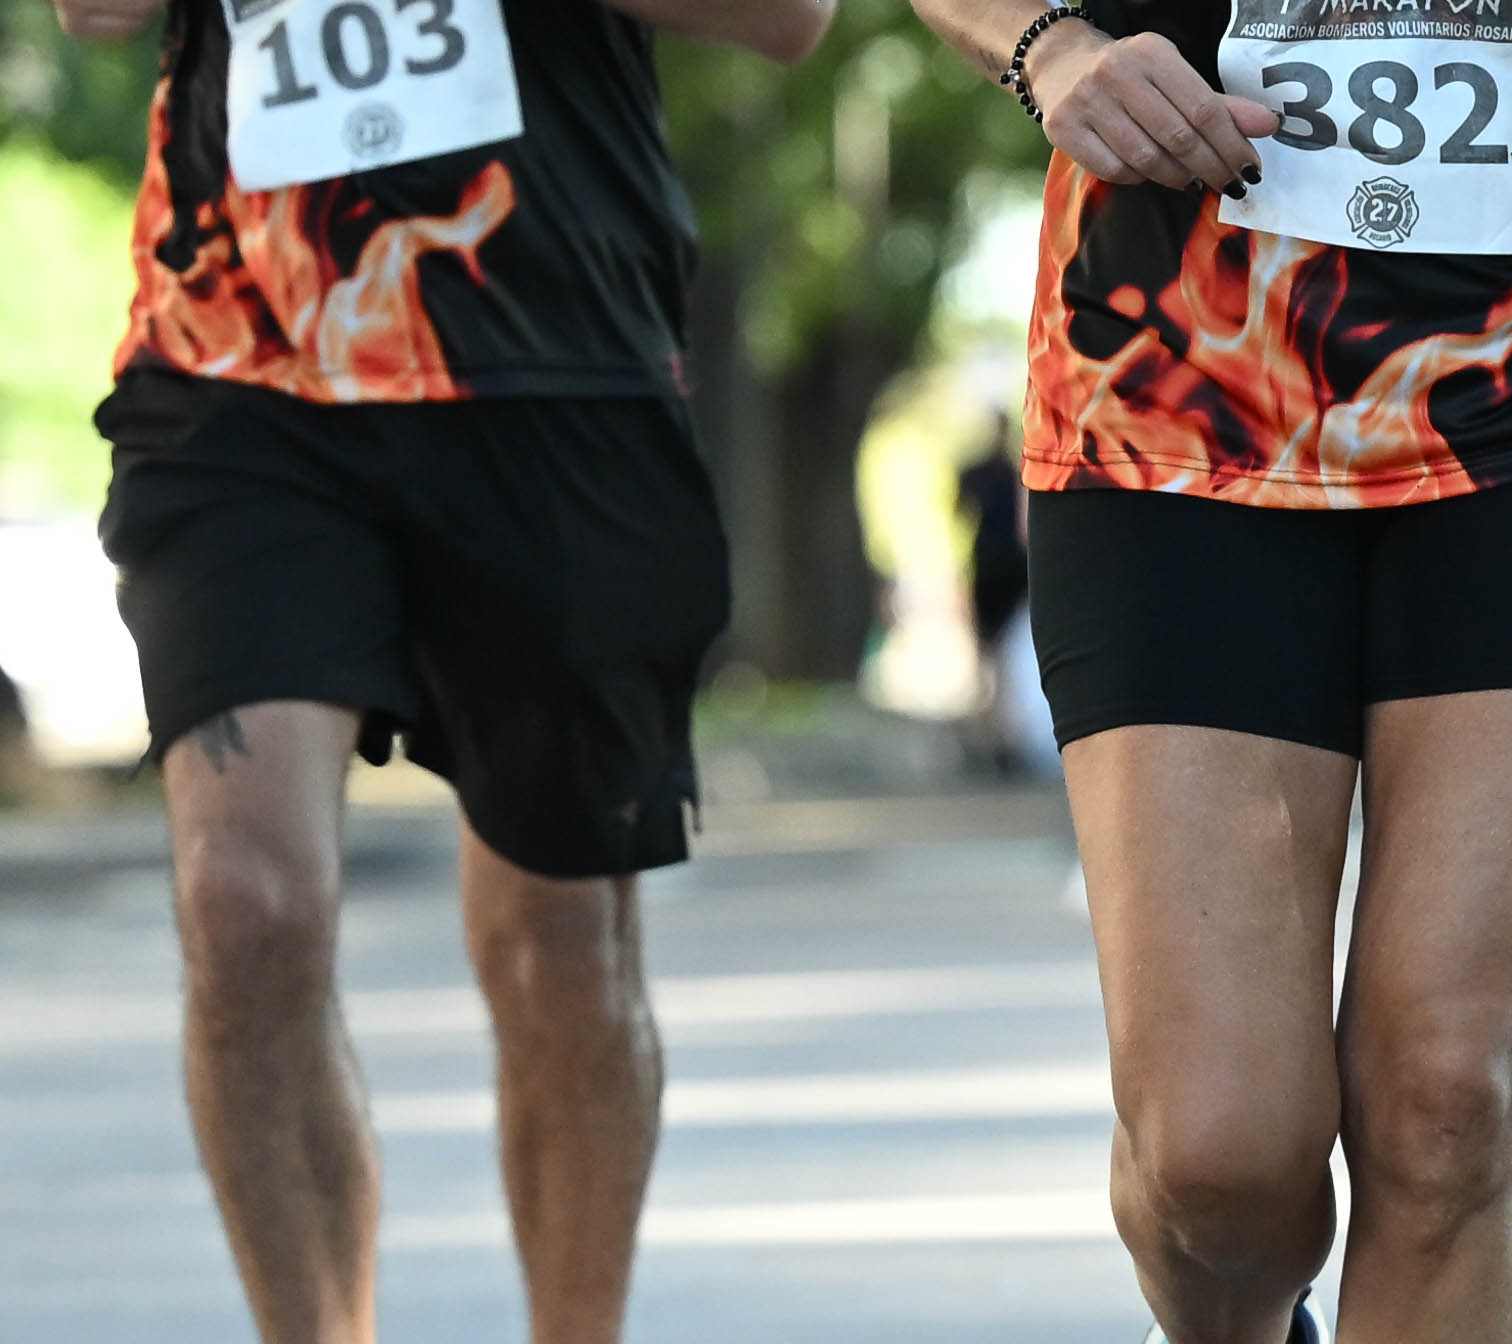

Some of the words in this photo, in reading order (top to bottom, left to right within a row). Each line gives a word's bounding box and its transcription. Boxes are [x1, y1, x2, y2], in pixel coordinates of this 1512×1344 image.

[1240, 21, 1315, 40] ASOCIACIÓN
[1318, 22, 1385, 39] BOMBEROS
[1387, 21, 1471, 38] VOLUNTARIOS
[1261, 60, 1509, 166] 382
[1369, 197, 1399, 222] 27
